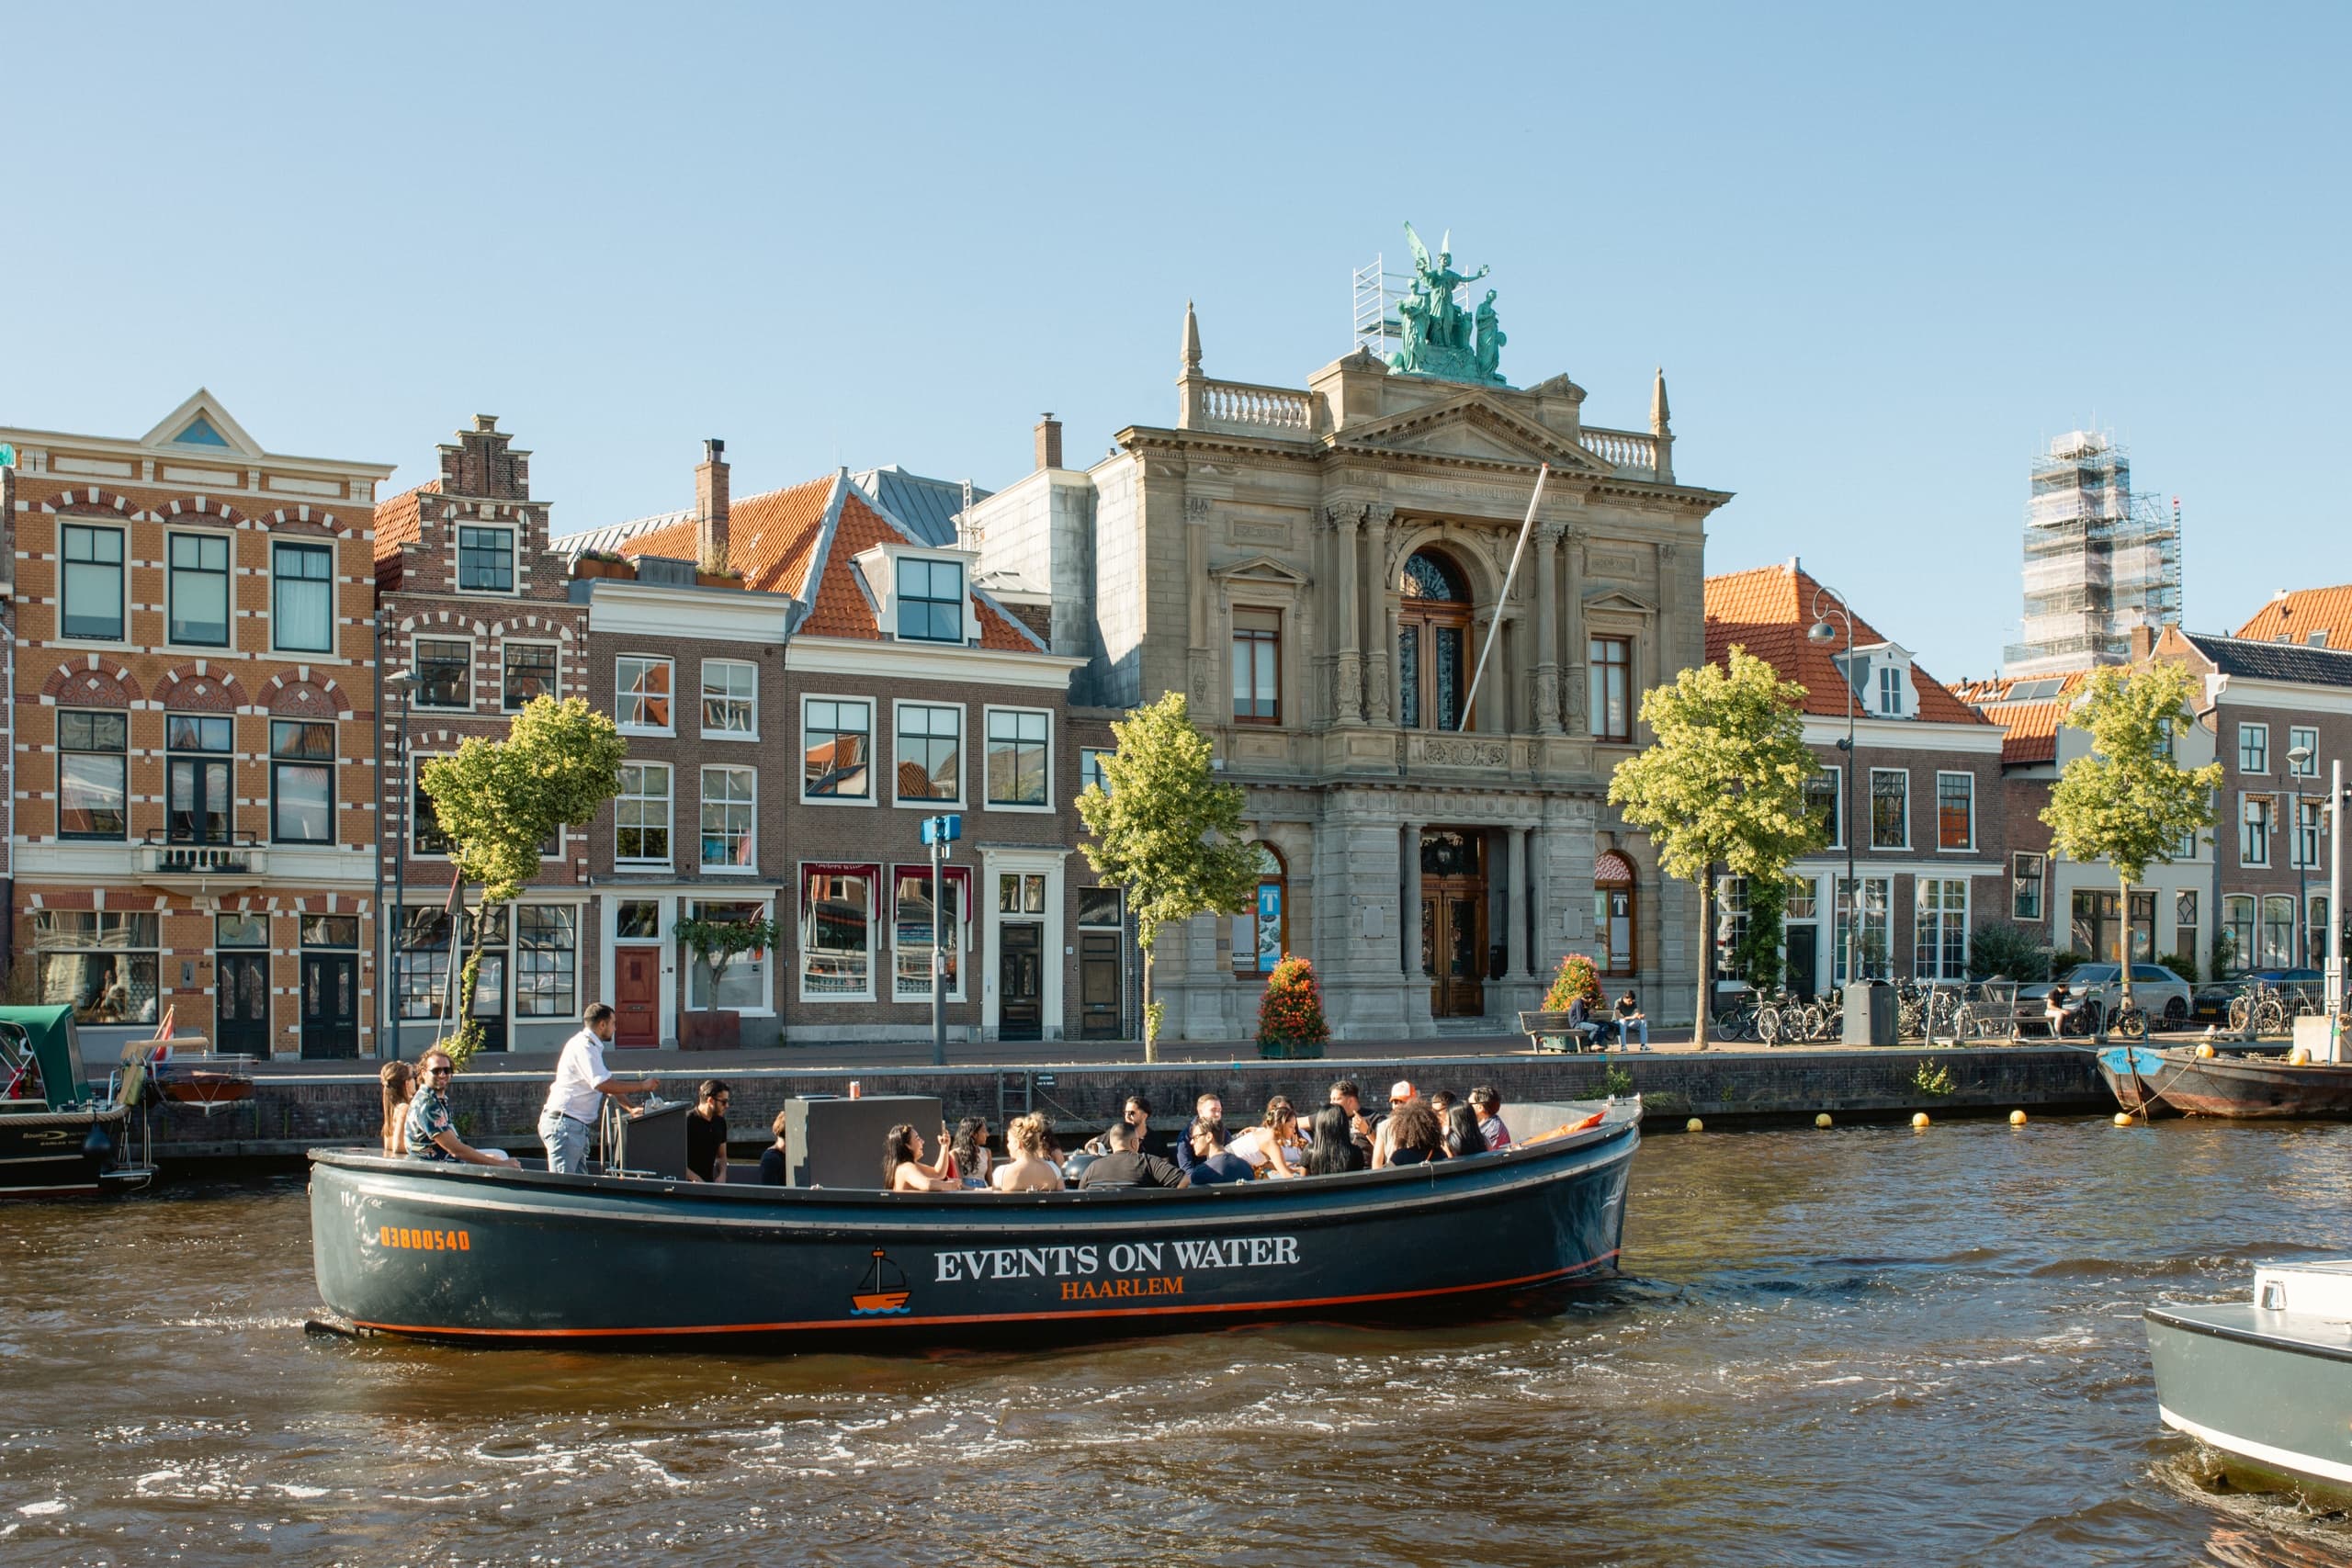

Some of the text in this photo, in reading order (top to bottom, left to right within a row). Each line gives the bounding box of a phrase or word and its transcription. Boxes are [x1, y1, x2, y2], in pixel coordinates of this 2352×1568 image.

[381, 1227, 470, 1251] 03800540
[934, 1236, 1300, 1282] EVENTS ON WATER
[1061, 1276, 1183, 1301] HAARLEM
